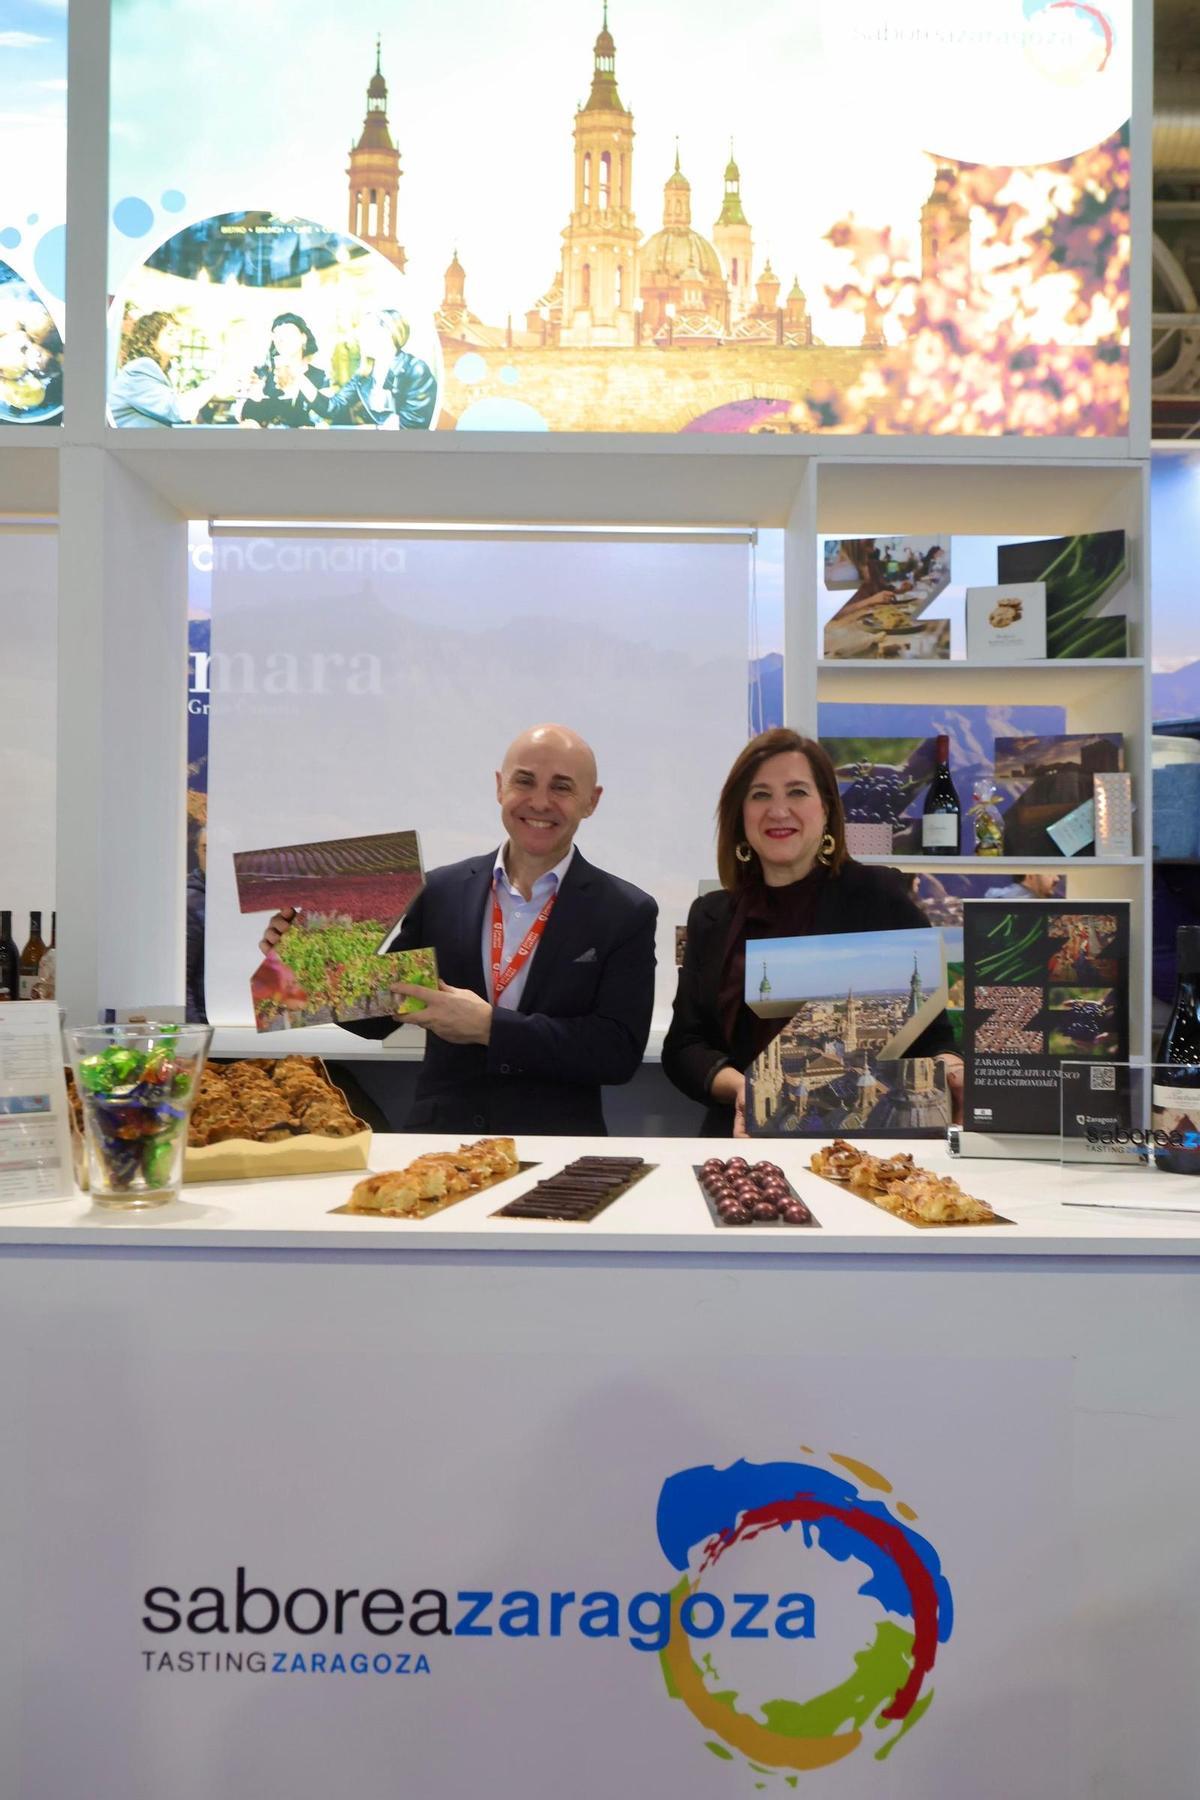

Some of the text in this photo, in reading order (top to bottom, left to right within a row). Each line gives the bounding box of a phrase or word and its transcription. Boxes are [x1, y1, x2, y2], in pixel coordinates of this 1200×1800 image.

[974, 1058, 1021, 1067] ZARAGOZA
[974, 1068, 1006, 1076] CIUDAD
[1006, 1068, 1046, 1077] CREATIVA
[974, 1078, 987, 1086] DE
[142, 1567, 816, 1652] saboreazaragoza
